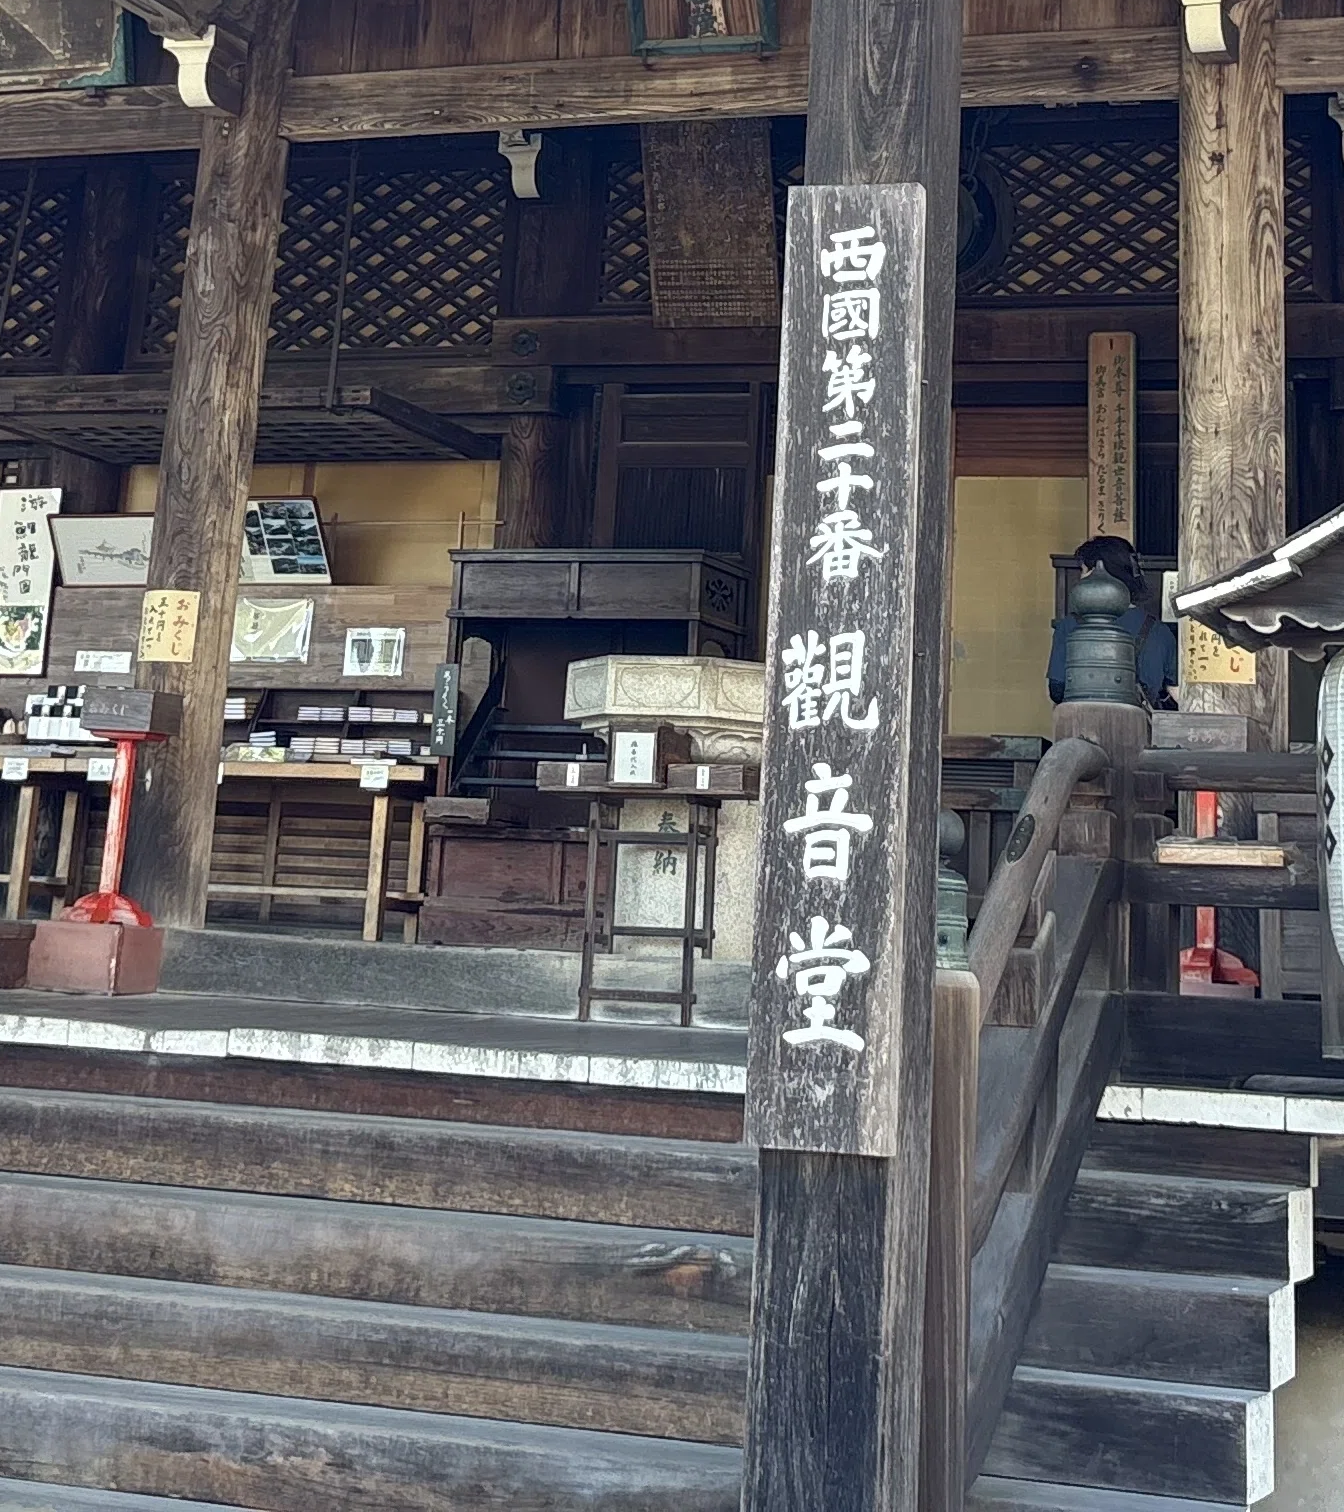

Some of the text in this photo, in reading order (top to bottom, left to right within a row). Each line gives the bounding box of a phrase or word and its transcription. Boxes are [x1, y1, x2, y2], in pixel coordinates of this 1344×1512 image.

[171, 598, 191, 657] おみくじ
[776, 226, 887, 1053] 西國第二十番 觀音堂
